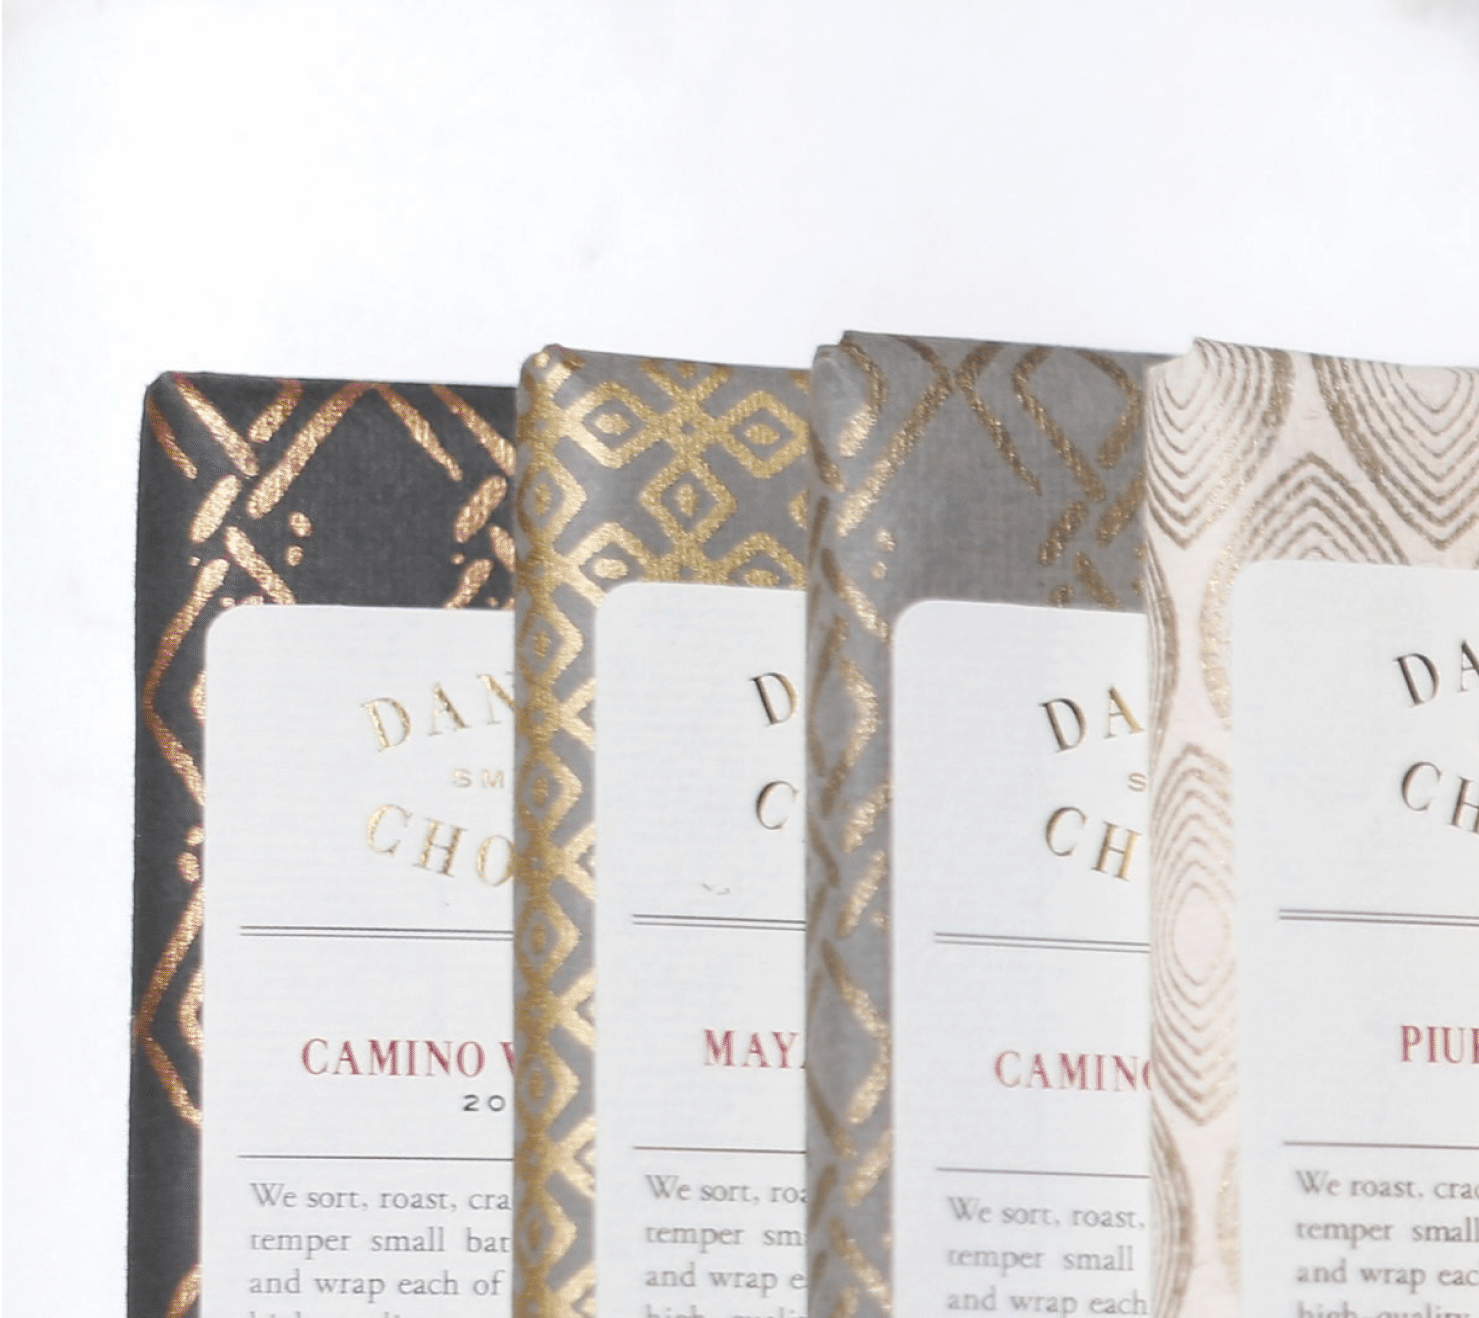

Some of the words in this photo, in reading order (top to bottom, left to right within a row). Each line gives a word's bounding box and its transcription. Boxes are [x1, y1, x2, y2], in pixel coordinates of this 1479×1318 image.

[300, 1037, 486, 1077] CAMINO
[369, 1225, 446, 1253] small
[1061, 1243, 1135, 1272] small
[396, 1268, 460, 1296] each
[1087, 1289, 1148, 1316] each
